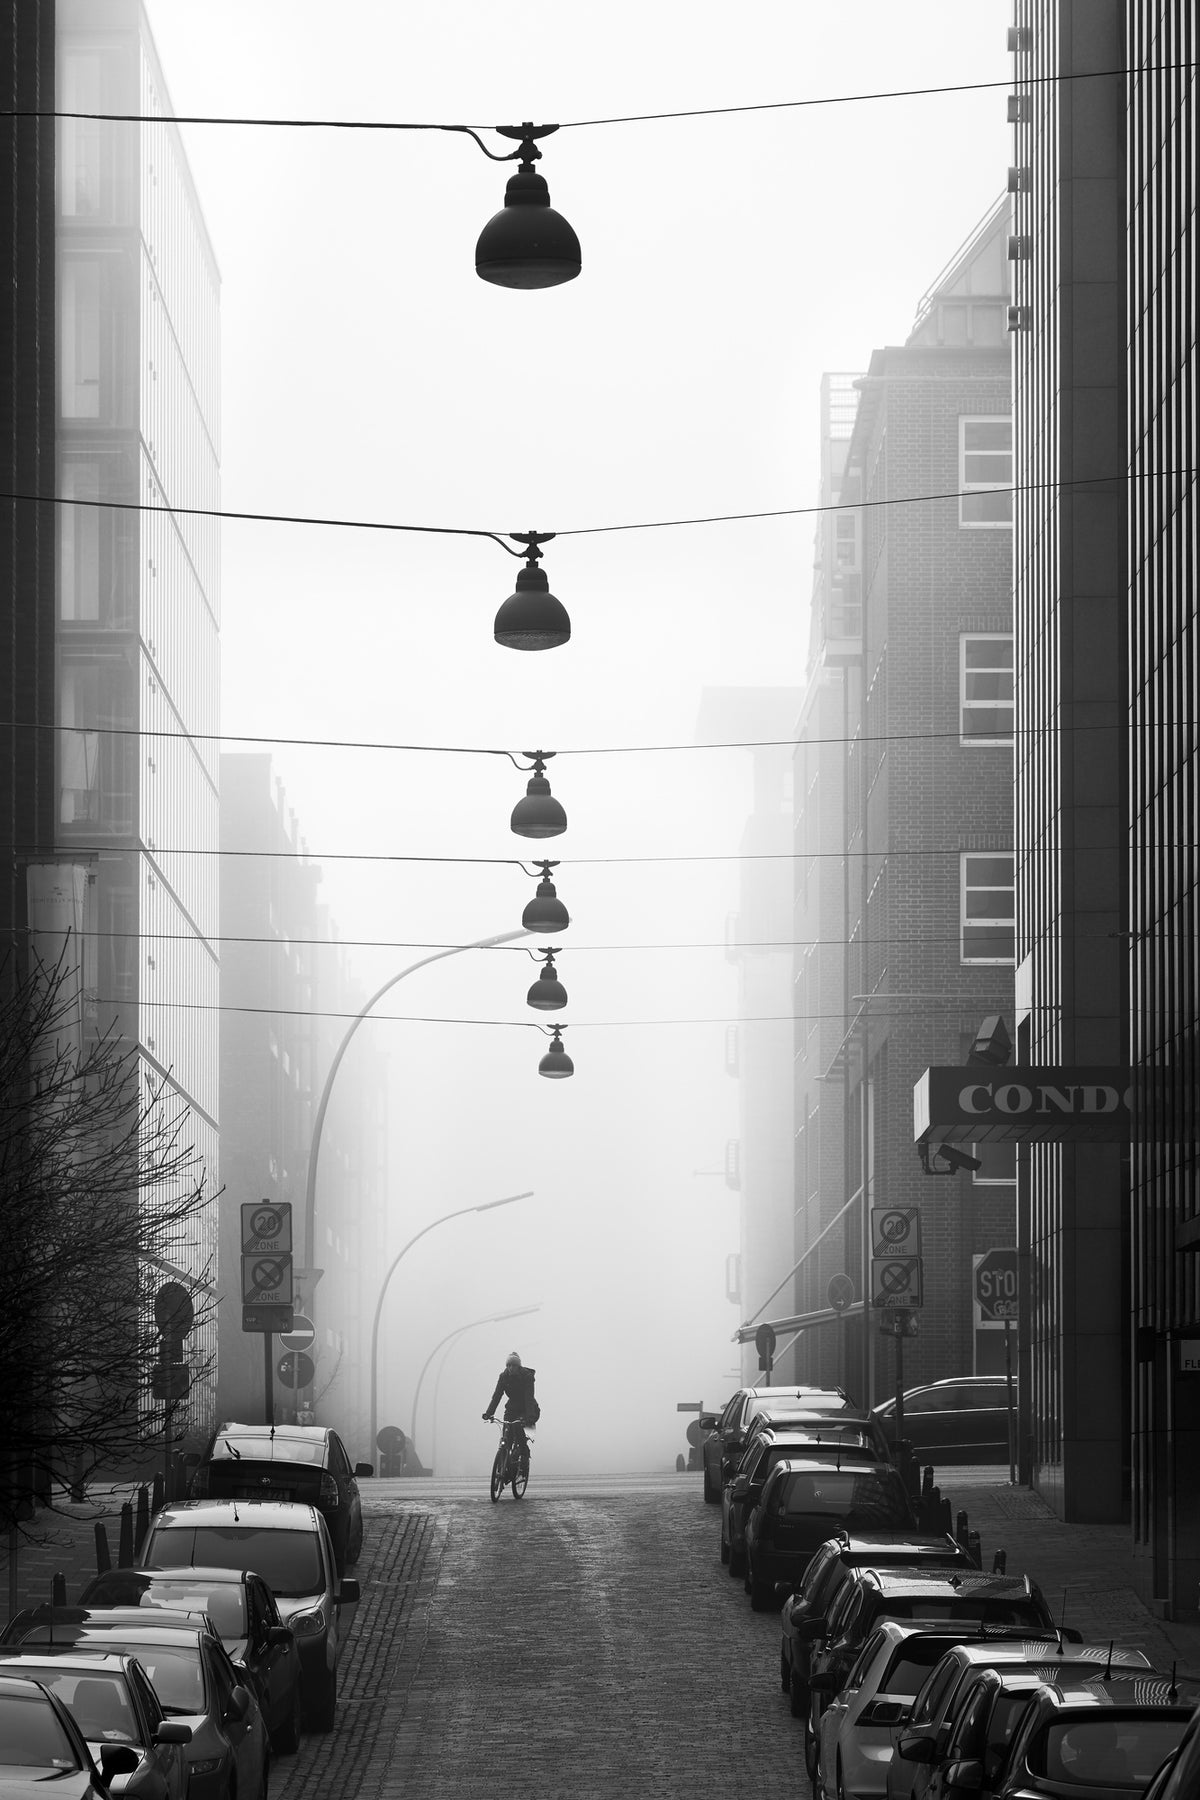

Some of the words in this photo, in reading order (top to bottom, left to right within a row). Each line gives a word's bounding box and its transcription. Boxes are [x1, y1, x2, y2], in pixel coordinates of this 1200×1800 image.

[257, 1215, 276, 1231] 20
[886, 1220, 904, 1236] 20
[255, 1241, 279, 1250] ZONE
